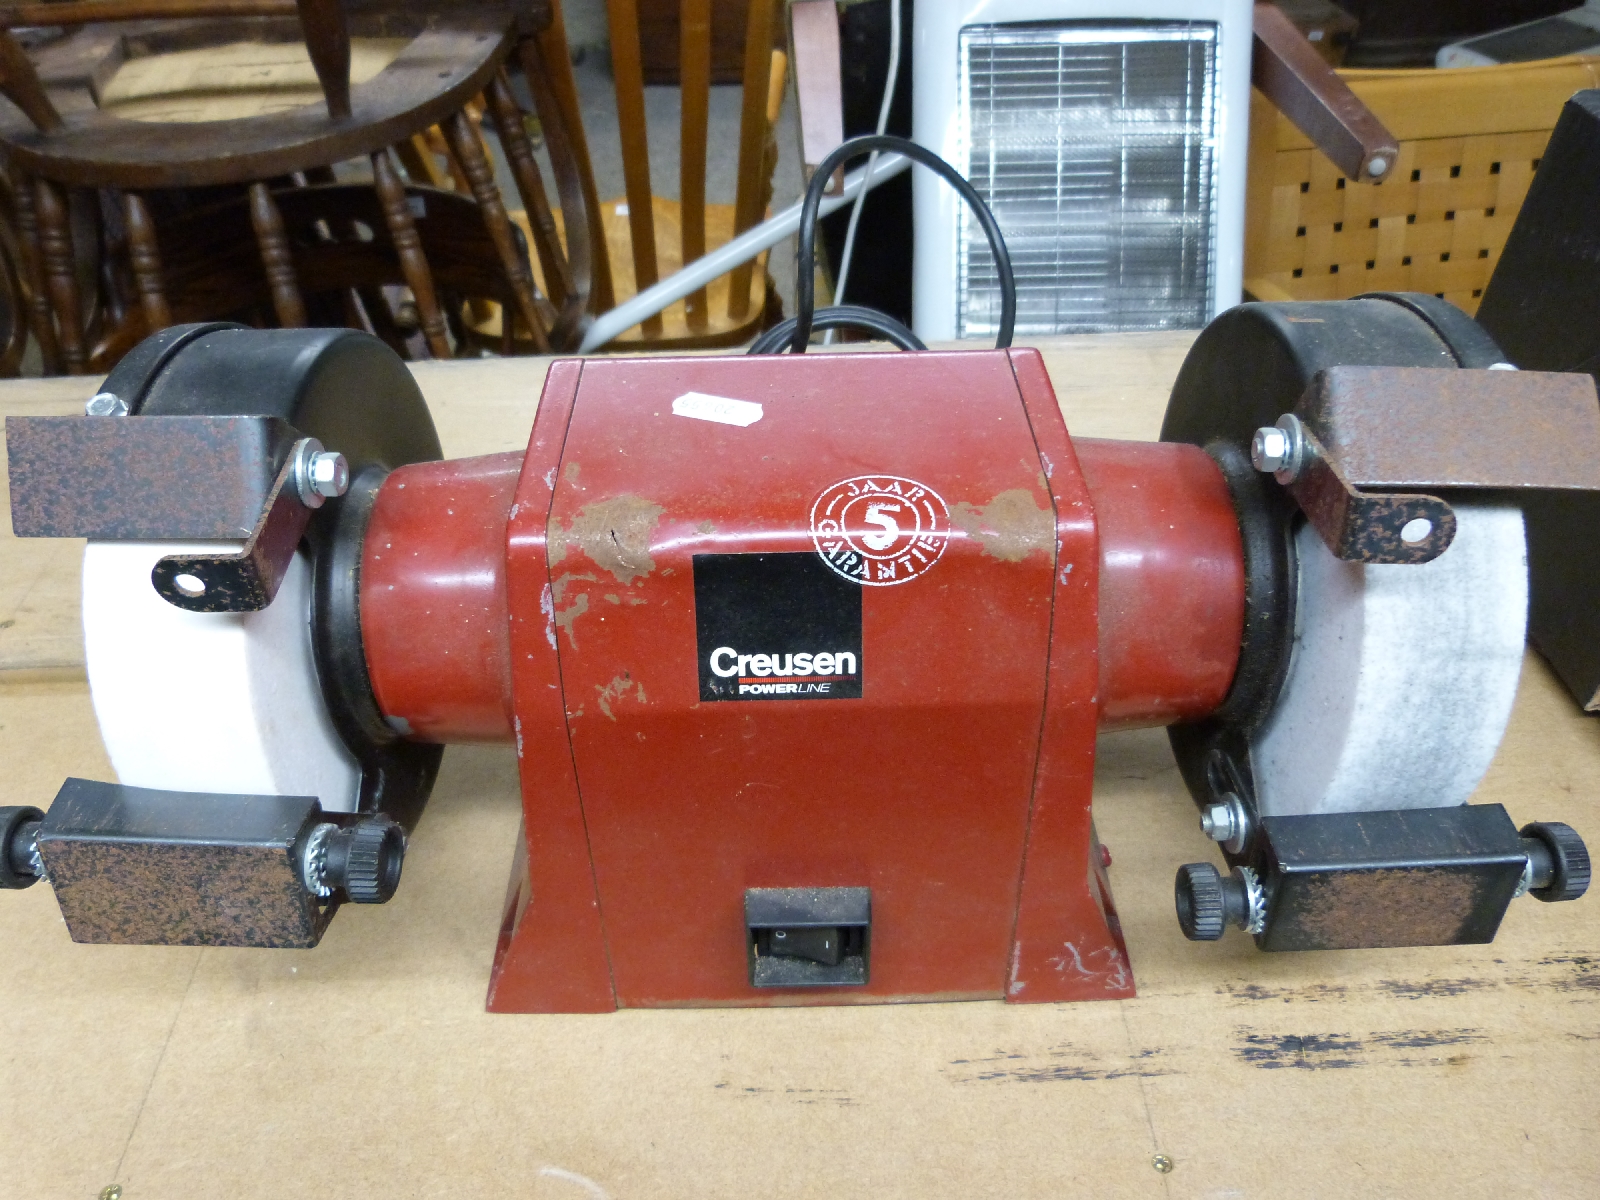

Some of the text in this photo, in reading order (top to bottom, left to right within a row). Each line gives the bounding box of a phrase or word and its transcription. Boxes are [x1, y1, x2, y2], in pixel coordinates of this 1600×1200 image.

[847, 479, 925, 502] JAAR
[861, 501, 901, 550] 5
[709, 646, 857, 678] Creusen
[738, 682, 832, 695] POWERLINE
